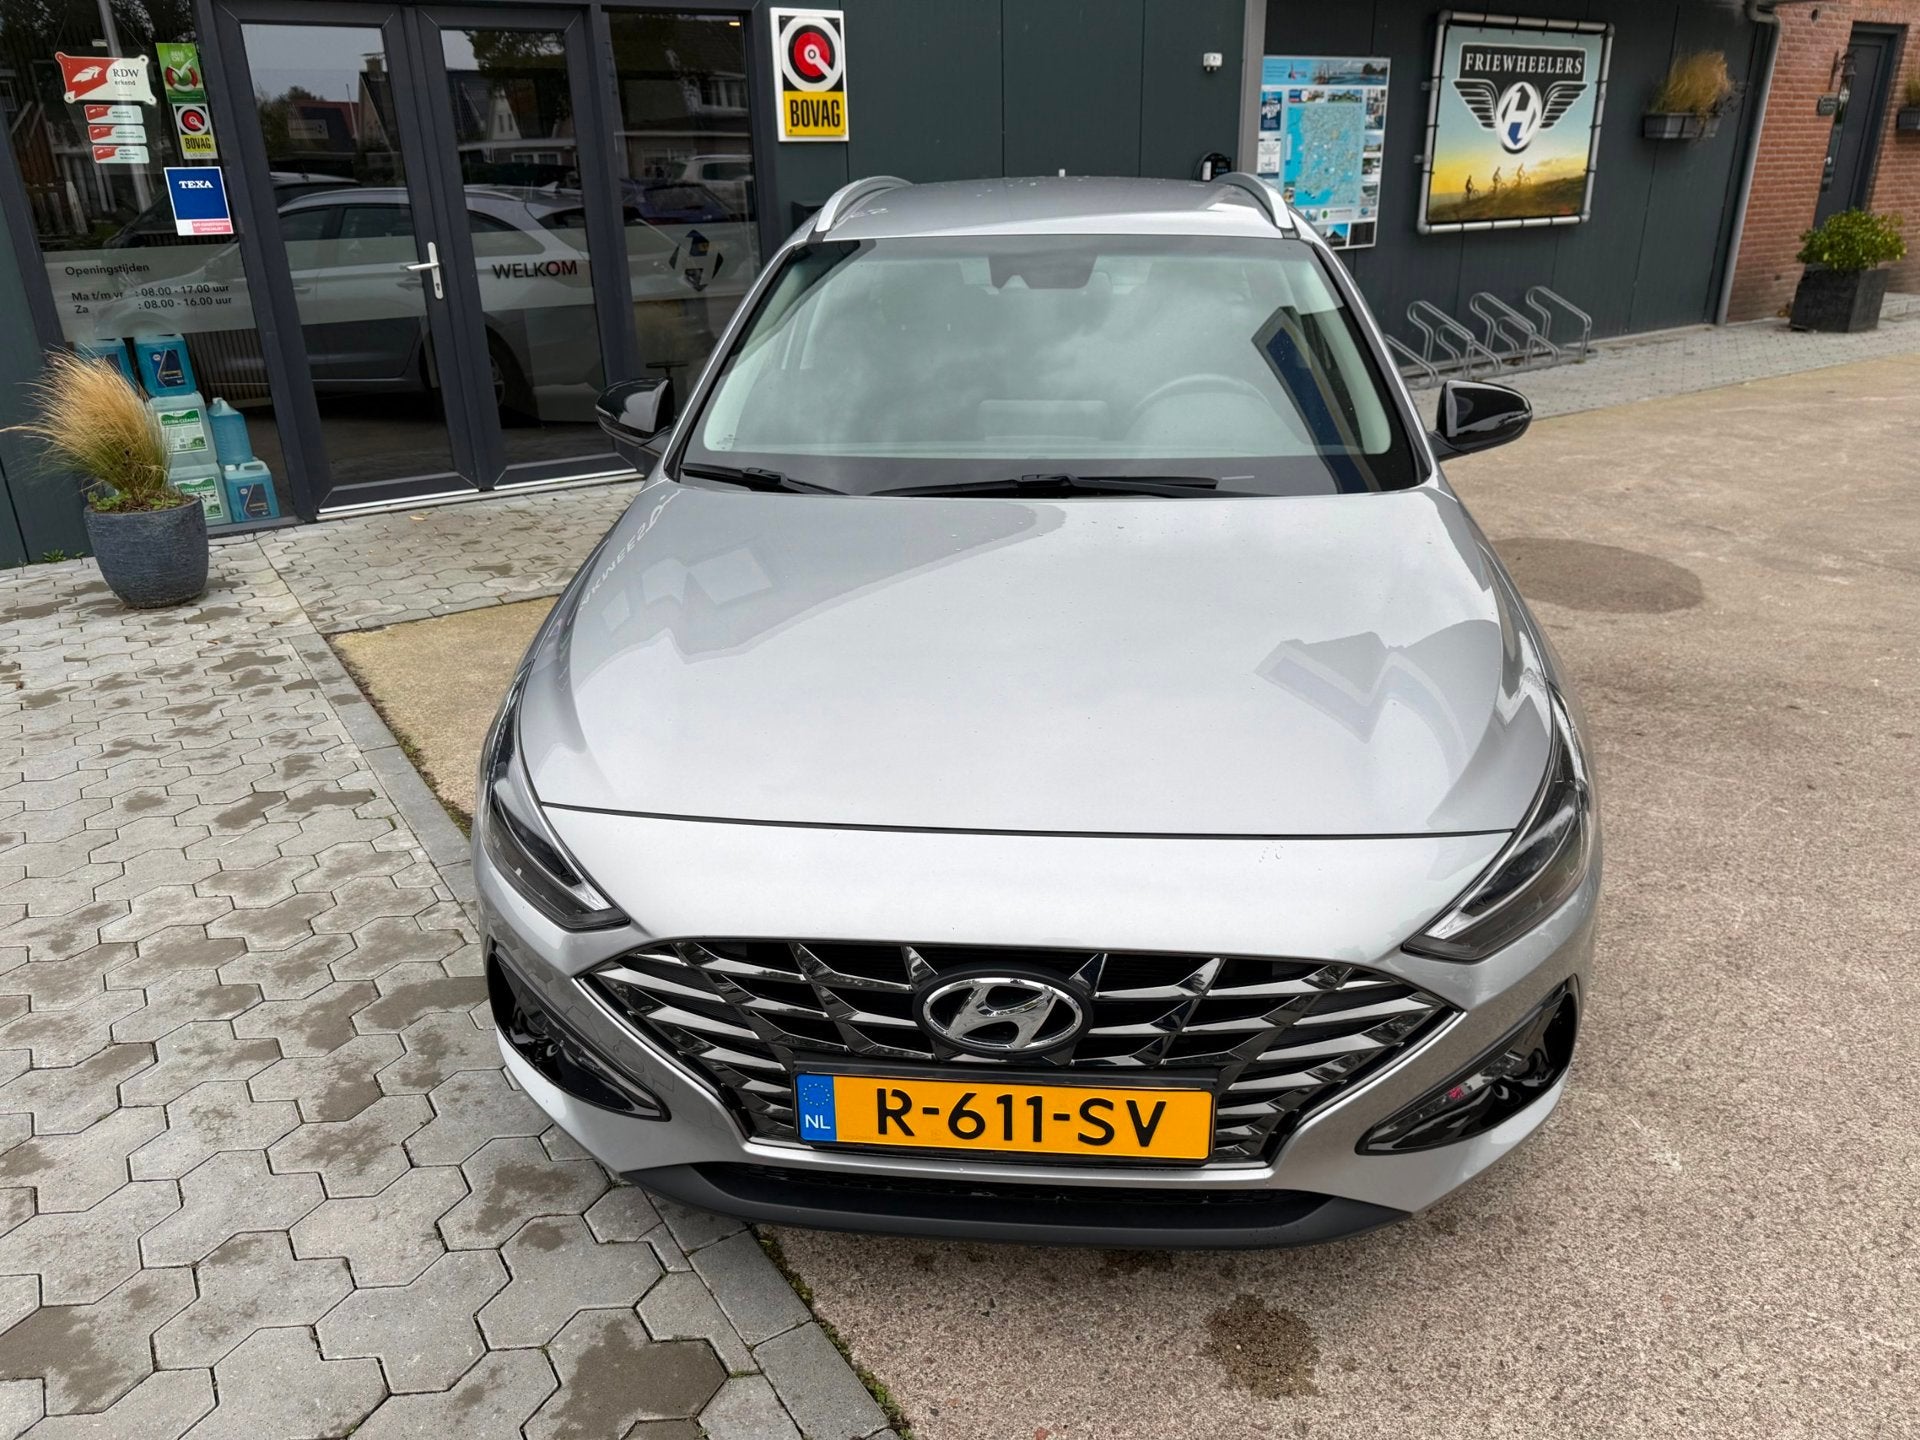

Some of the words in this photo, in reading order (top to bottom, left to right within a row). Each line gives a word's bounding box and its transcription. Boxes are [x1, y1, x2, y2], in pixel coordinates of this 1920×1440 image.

[1464, 52, 1583, 75] FRIEWHEELERS
[112, 68, 140, 78] RDW
[789, 99, 841, 128] BOVAG
[184, 137, 212, 150] BOVAG
[178, 180, 214, 189] TEXA
[65, 262, 150, 278] Openingstijden
[492, 260, 578, 279] WELKOM
[71, 291, 89, 302] Ma
[92, 289, 112, 301] t/m
[112, 291, 124, 300] vr
[141, 286, 172, 298] 08.00
[181, 284, 210, 295] 17.00
[212, 285, 229, 293] uur
[75, 304, 89, 314] Za
[144, 299, 174, 309] 08.00
[184, 296, 213, 307] 16.00
[215, 297, 232, 305] uur
[804, 1113, 831, 1131] NL
[876, 1087, 1168, 1148] R-611-SV
